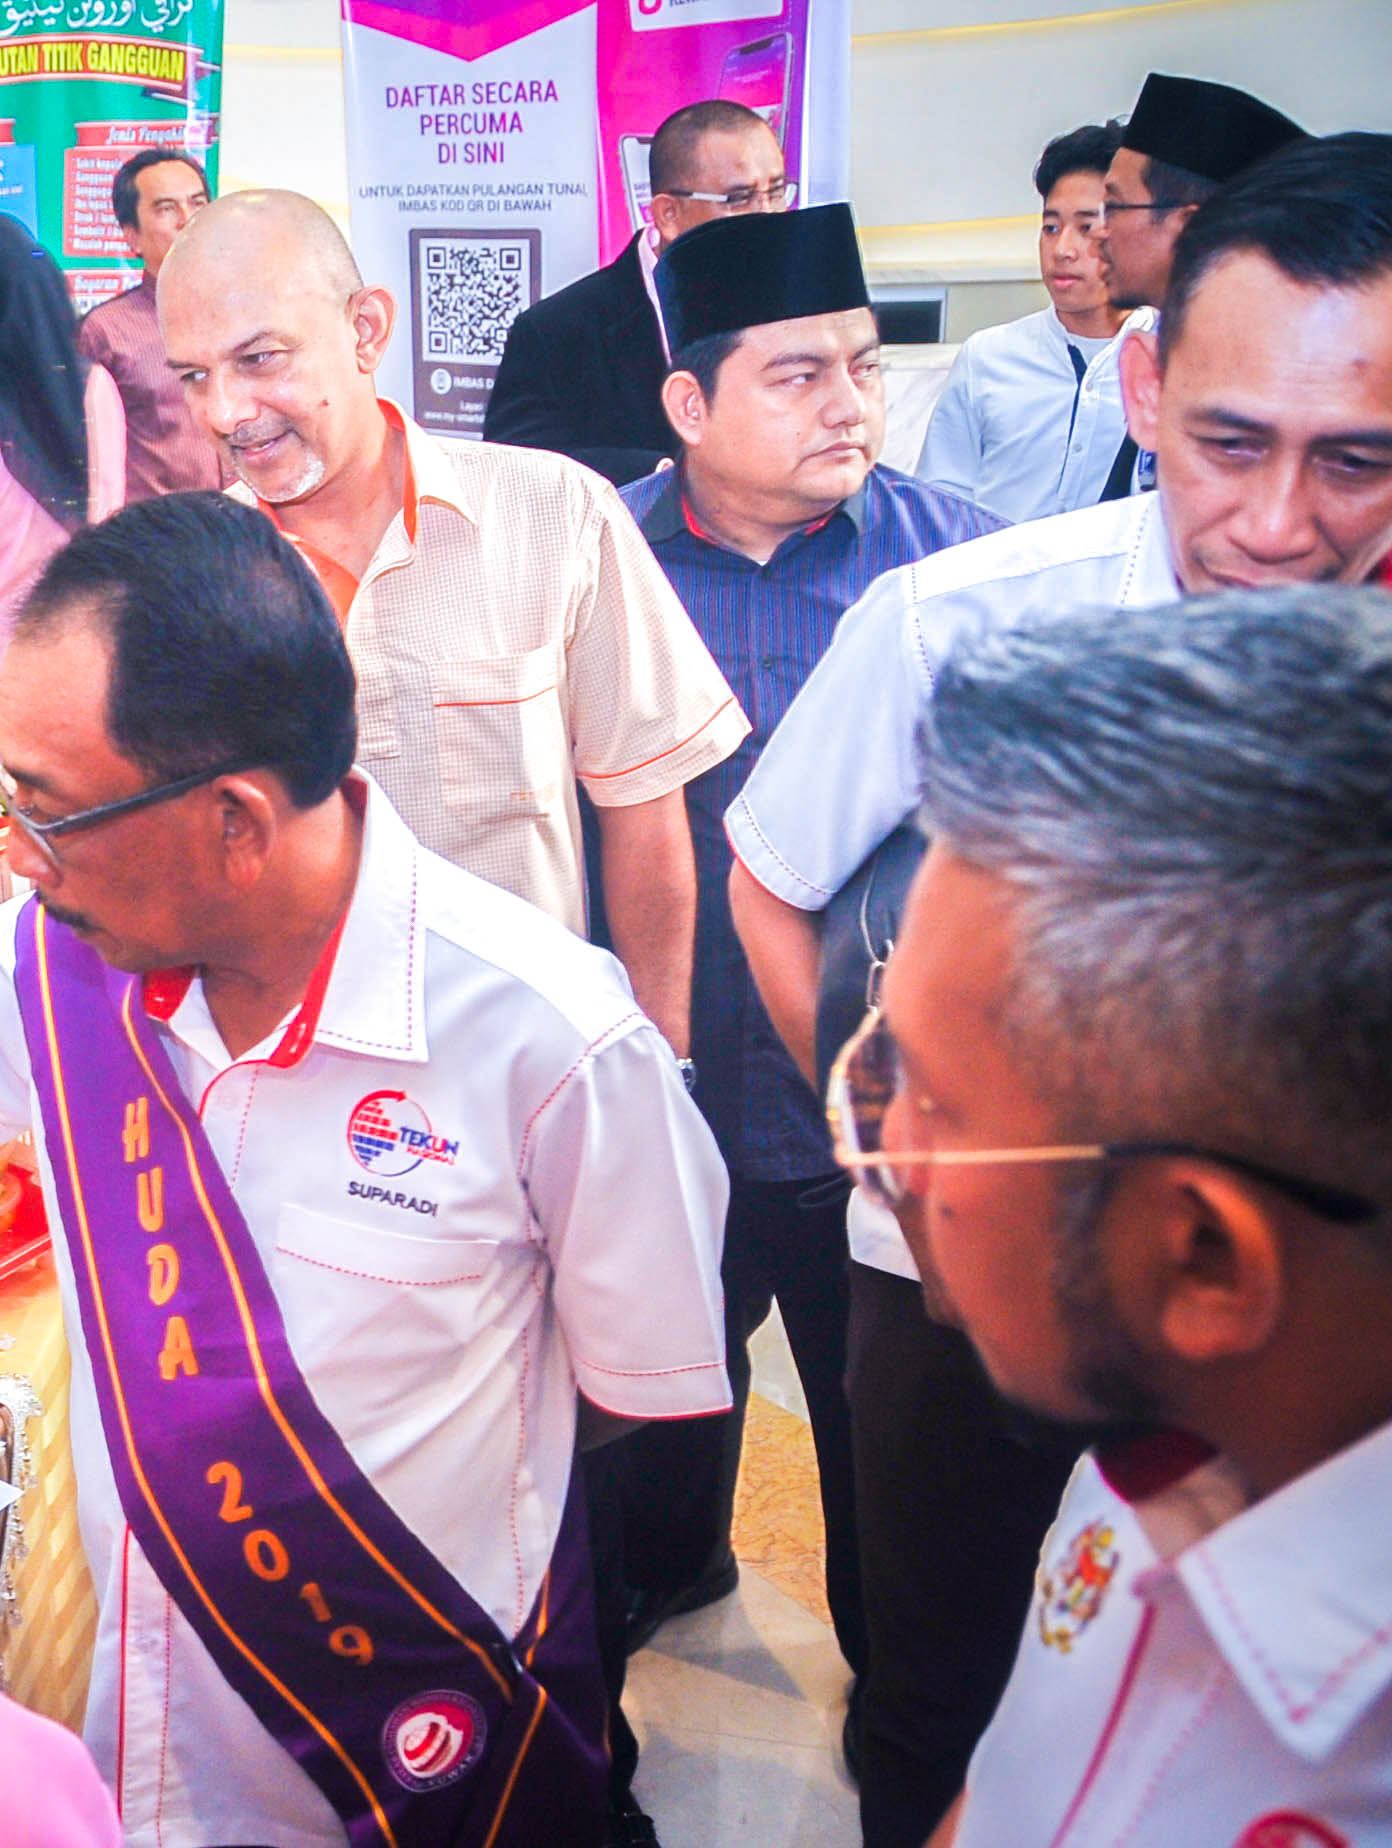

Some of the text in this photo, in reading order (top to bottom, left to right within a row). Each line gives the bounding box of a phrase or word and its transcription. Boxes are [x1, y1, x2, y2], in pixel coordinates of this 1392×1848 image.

[42, 42, 83, 72] TITIK
[87, 41, 185, 82] GANGGUAN
[385, 79, 559, 108] DAFTAR SECARA
[419, 111, 524, 136] PERCUMA
[437, 141, 505, 164] DI SINI
[359, 185, 403, 199] UNTUK
[406, 184, 470, 198] DAPATKAN
[472, 182, 544, 197] PULANGAN
[398, 199, 552, 212] IMBAS KOD QR DI BAWAH
[399, 1126, 460, 1157] TEKUN
[347, 1180, 439, 1217] SUPARADI
[122, 1096, 374, 1667] HUDA 2019
